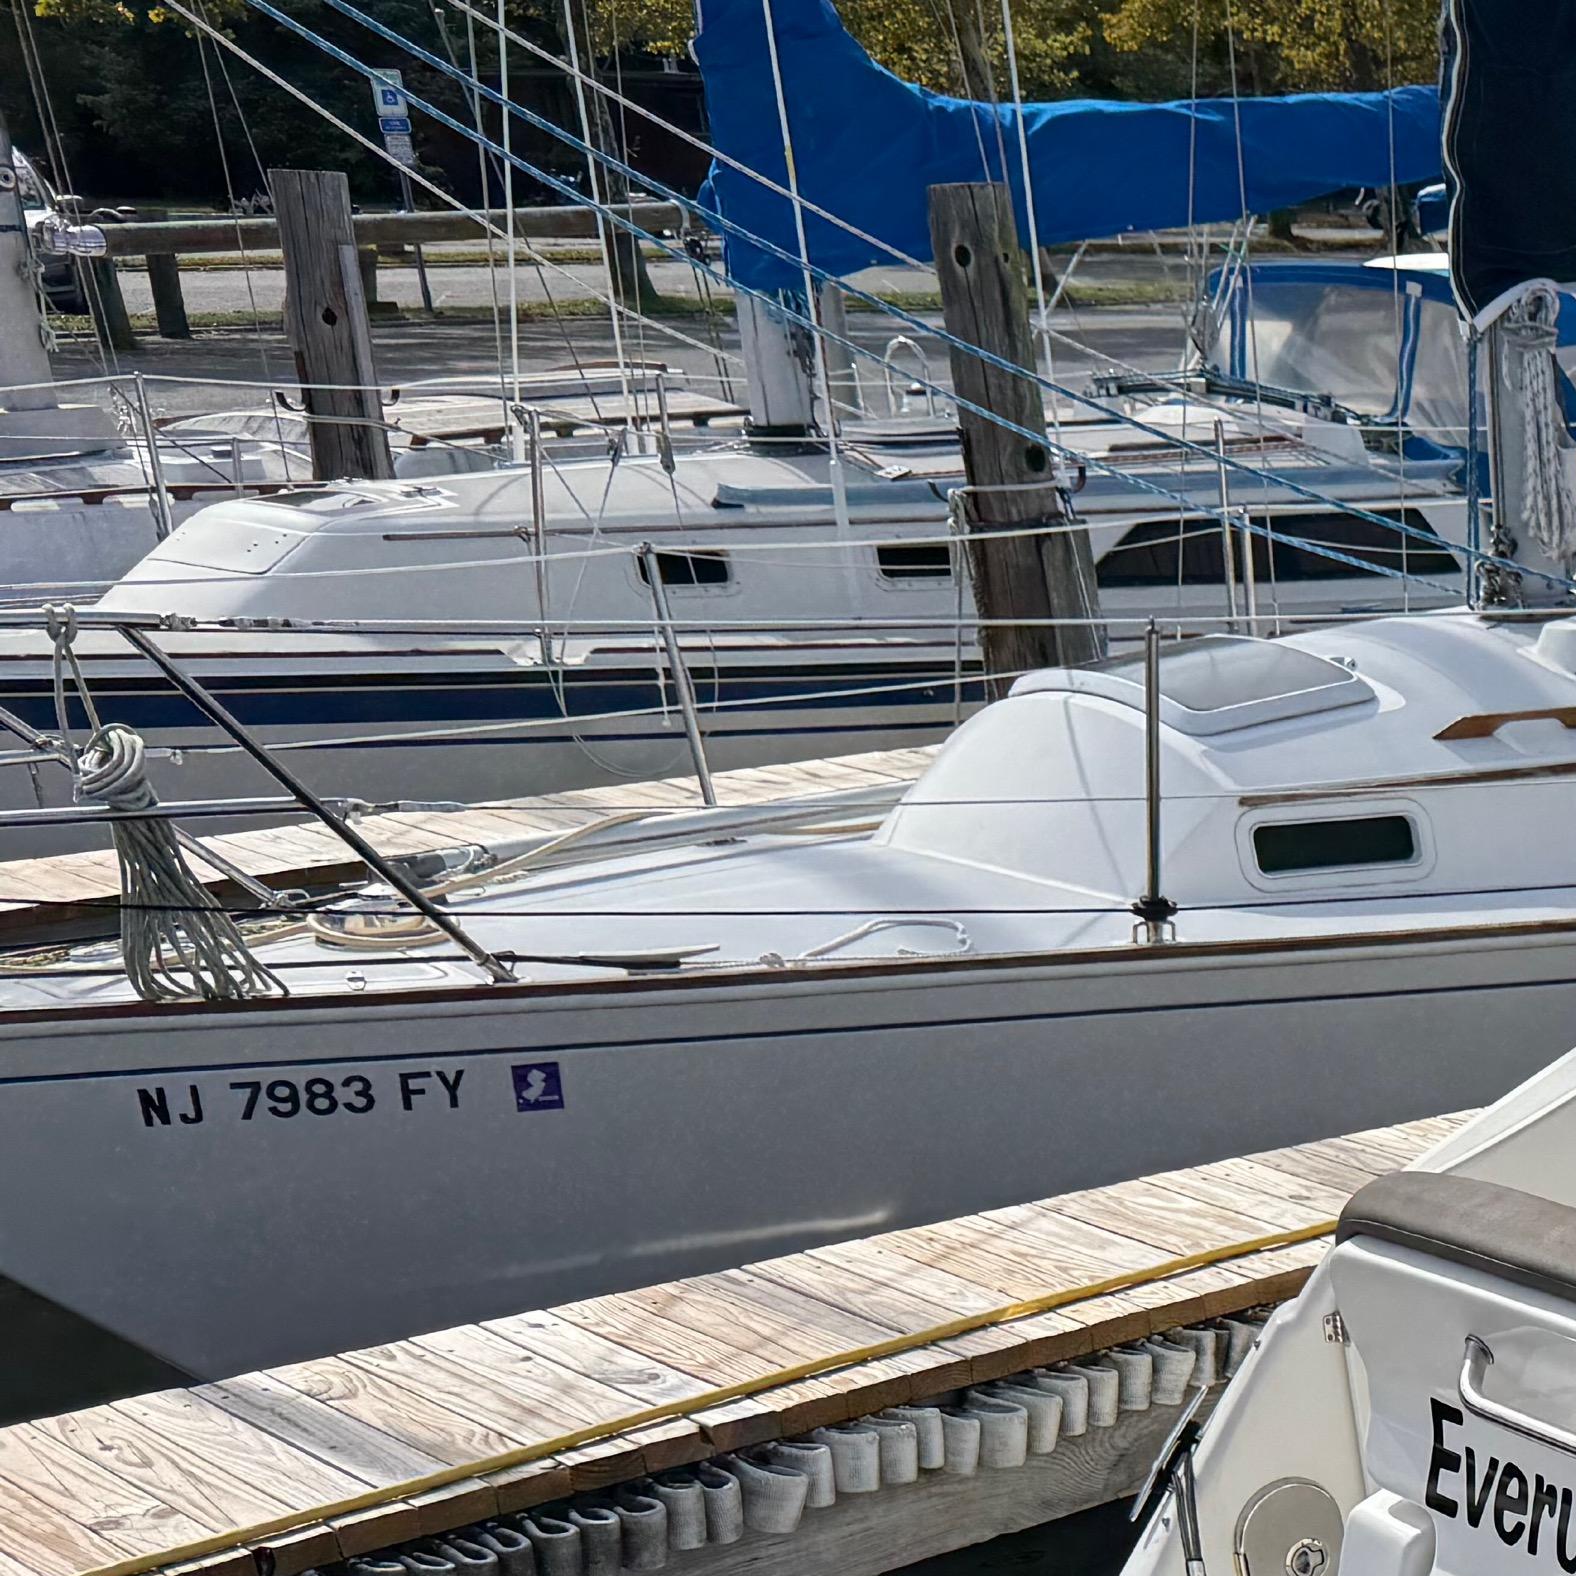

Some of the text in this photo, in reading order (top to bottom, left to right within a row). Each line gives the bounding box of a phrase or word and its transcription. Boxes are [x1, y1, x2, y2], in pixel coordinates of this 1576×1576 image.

[136, 1069, 465, 1127] NJ 7983 FY
